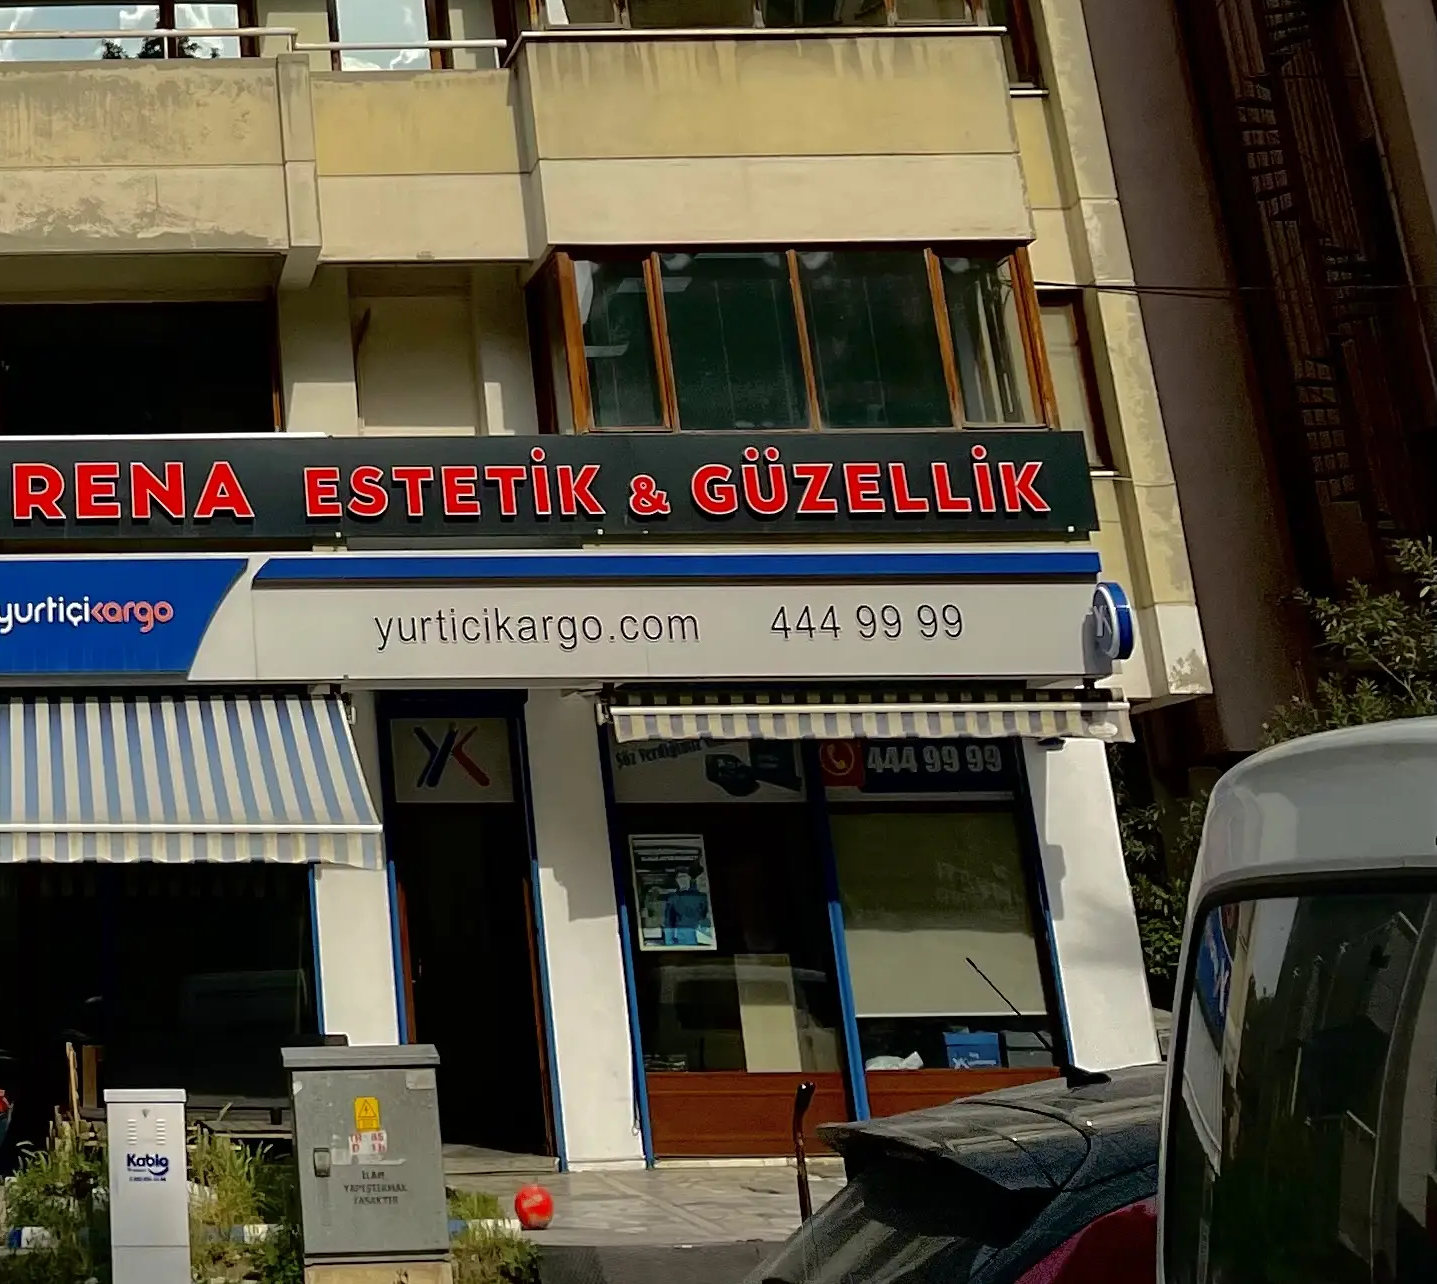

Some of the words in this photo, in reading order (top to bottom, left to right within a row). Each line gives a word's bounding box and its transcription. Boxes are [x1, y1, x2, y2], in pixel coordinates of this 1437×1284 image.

[13, 460, 256, 520] RENA
[303, 447, 607, 519] ESTETİK
[629, 473, 672, 516] &
[690, 444, 1052, 516] GÜZELLİK
[373, 607, 701, 651] yurticikargo.com
[770, 605, 841, 640] 444
[856, 604, 902, 639] 99
[917, 604, 963, 638] 99
[867, 746, 918, 773] 444
[922, 745, 961, 773] 99
[965, 744, 1003, 773] 99
